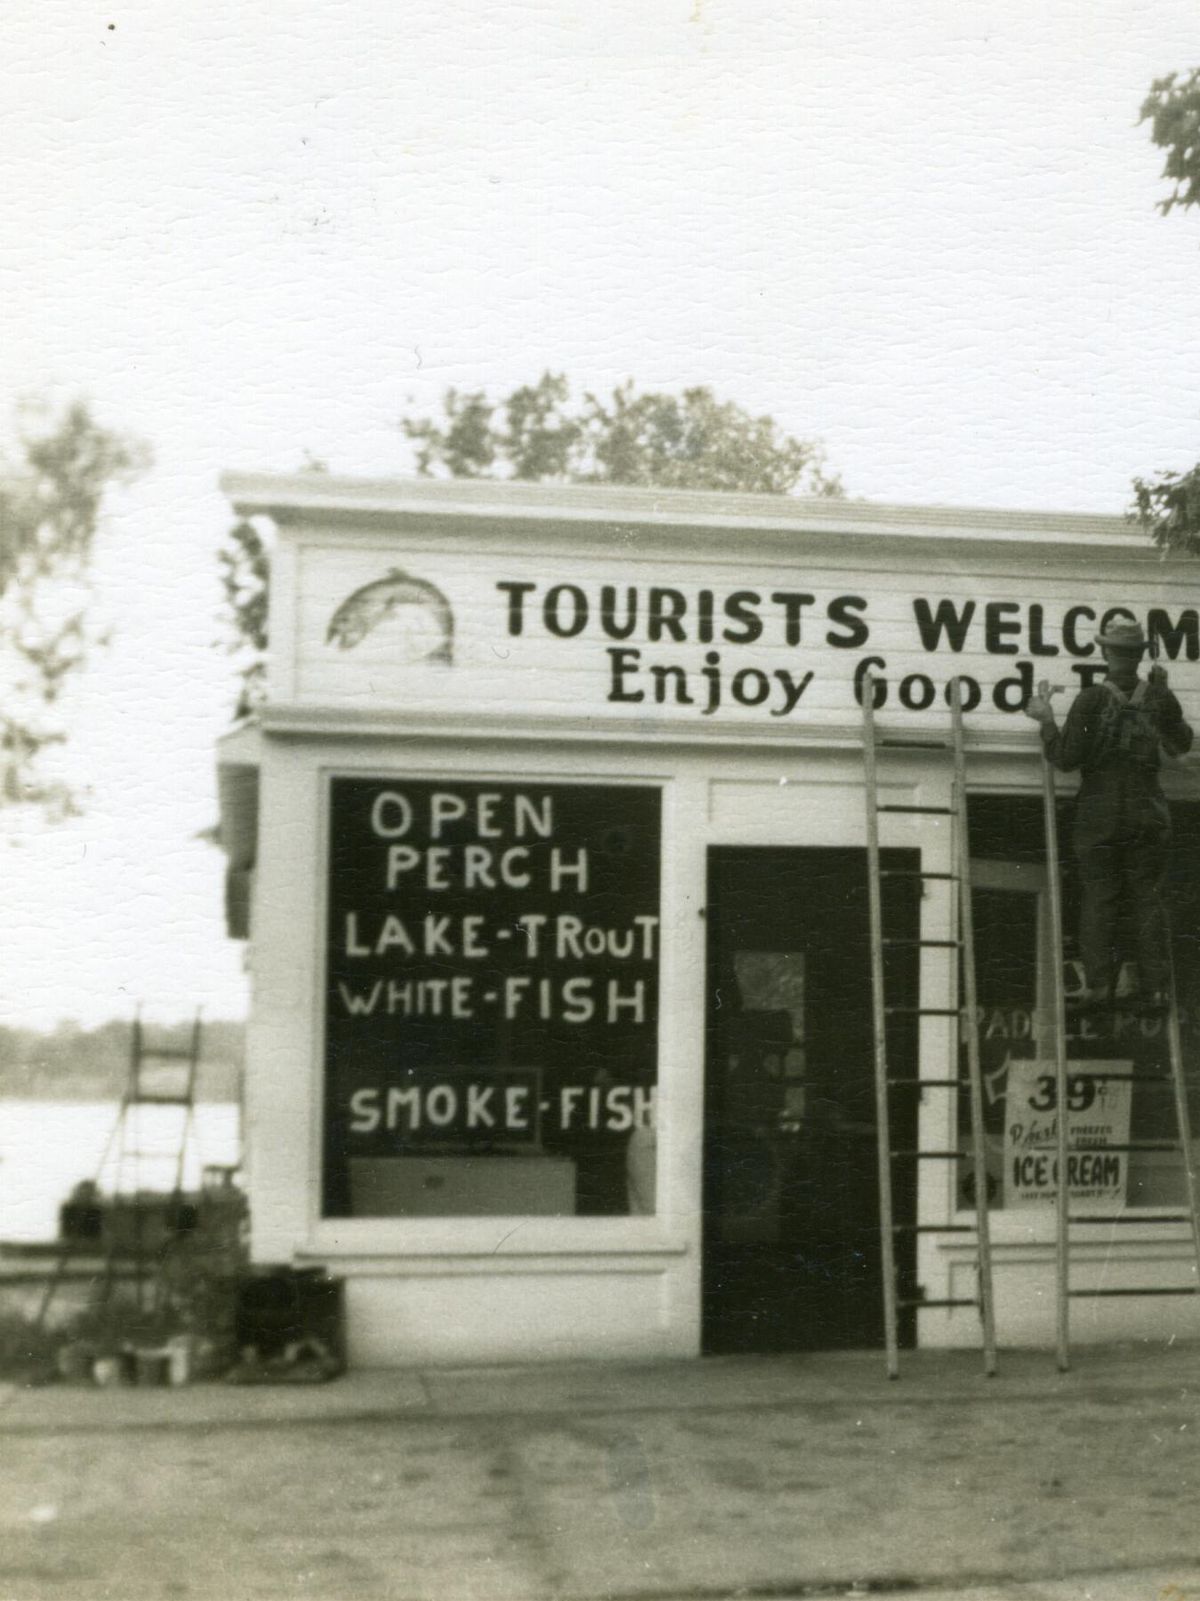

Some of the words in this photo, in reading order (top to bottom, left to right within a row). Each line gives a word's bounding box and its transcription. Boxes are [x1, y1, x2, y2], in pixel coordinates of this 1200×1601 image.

[496, 581, 870, 649] TOURISTS
[606, 646, 814, 716] Enjoy
[854, 656, 1034, 713] Good
[370, 791, 553, 839] OPEN
[386, 844, 588, 893] PERCH
[1013, 1155, 1048, 1187] ICE
